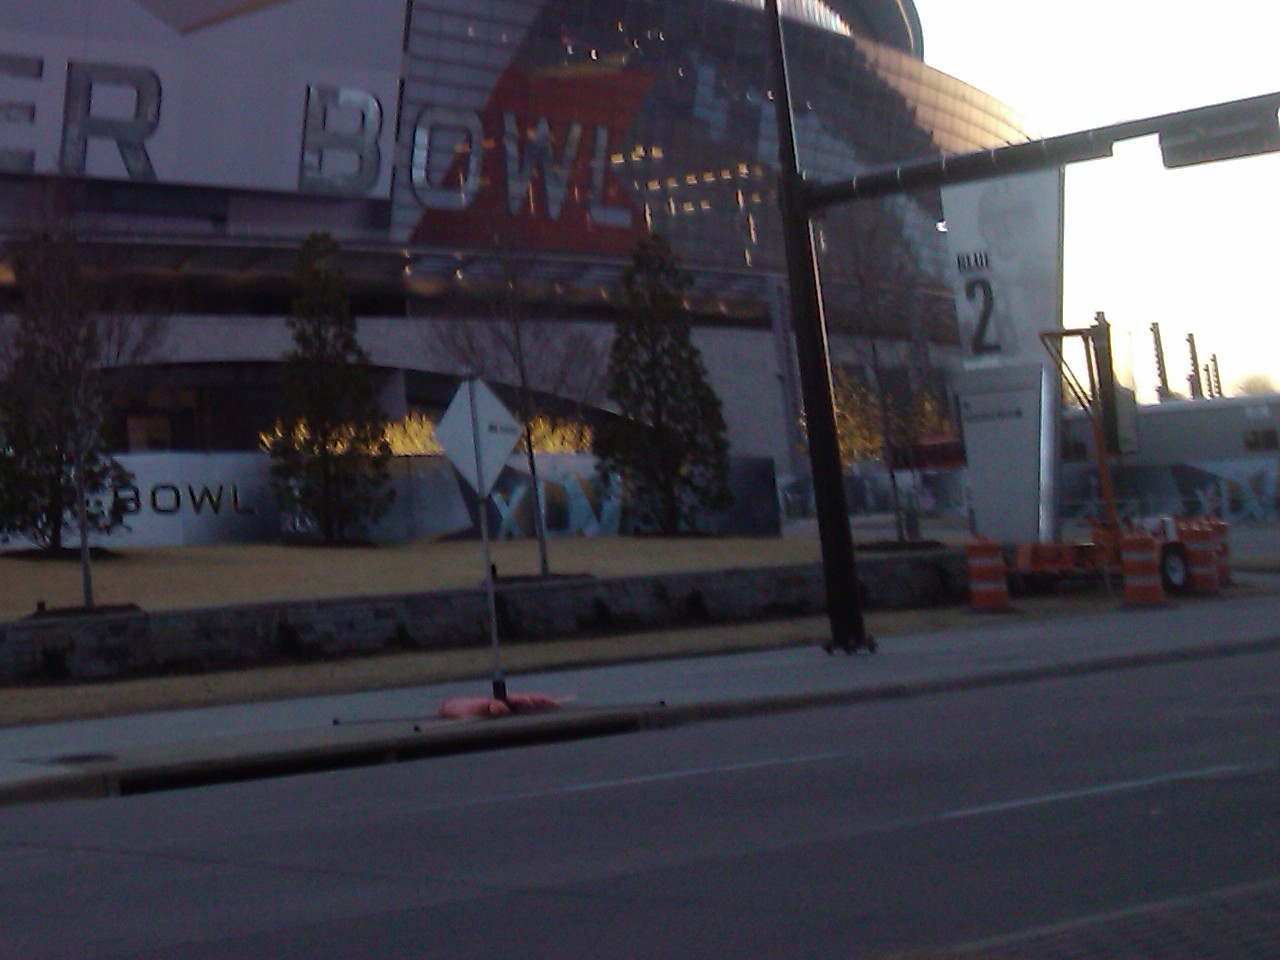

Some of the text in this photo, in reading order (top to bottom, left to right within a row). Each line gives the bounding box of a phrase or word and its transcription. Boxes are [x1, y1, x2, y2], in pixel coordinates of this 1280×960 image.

[297, 84, 633, 230] BOWL
[965, 278, 1002, 354] 2
[113, 483, 258, 515] BOWL
[488, 470, 623, 540] XLV
